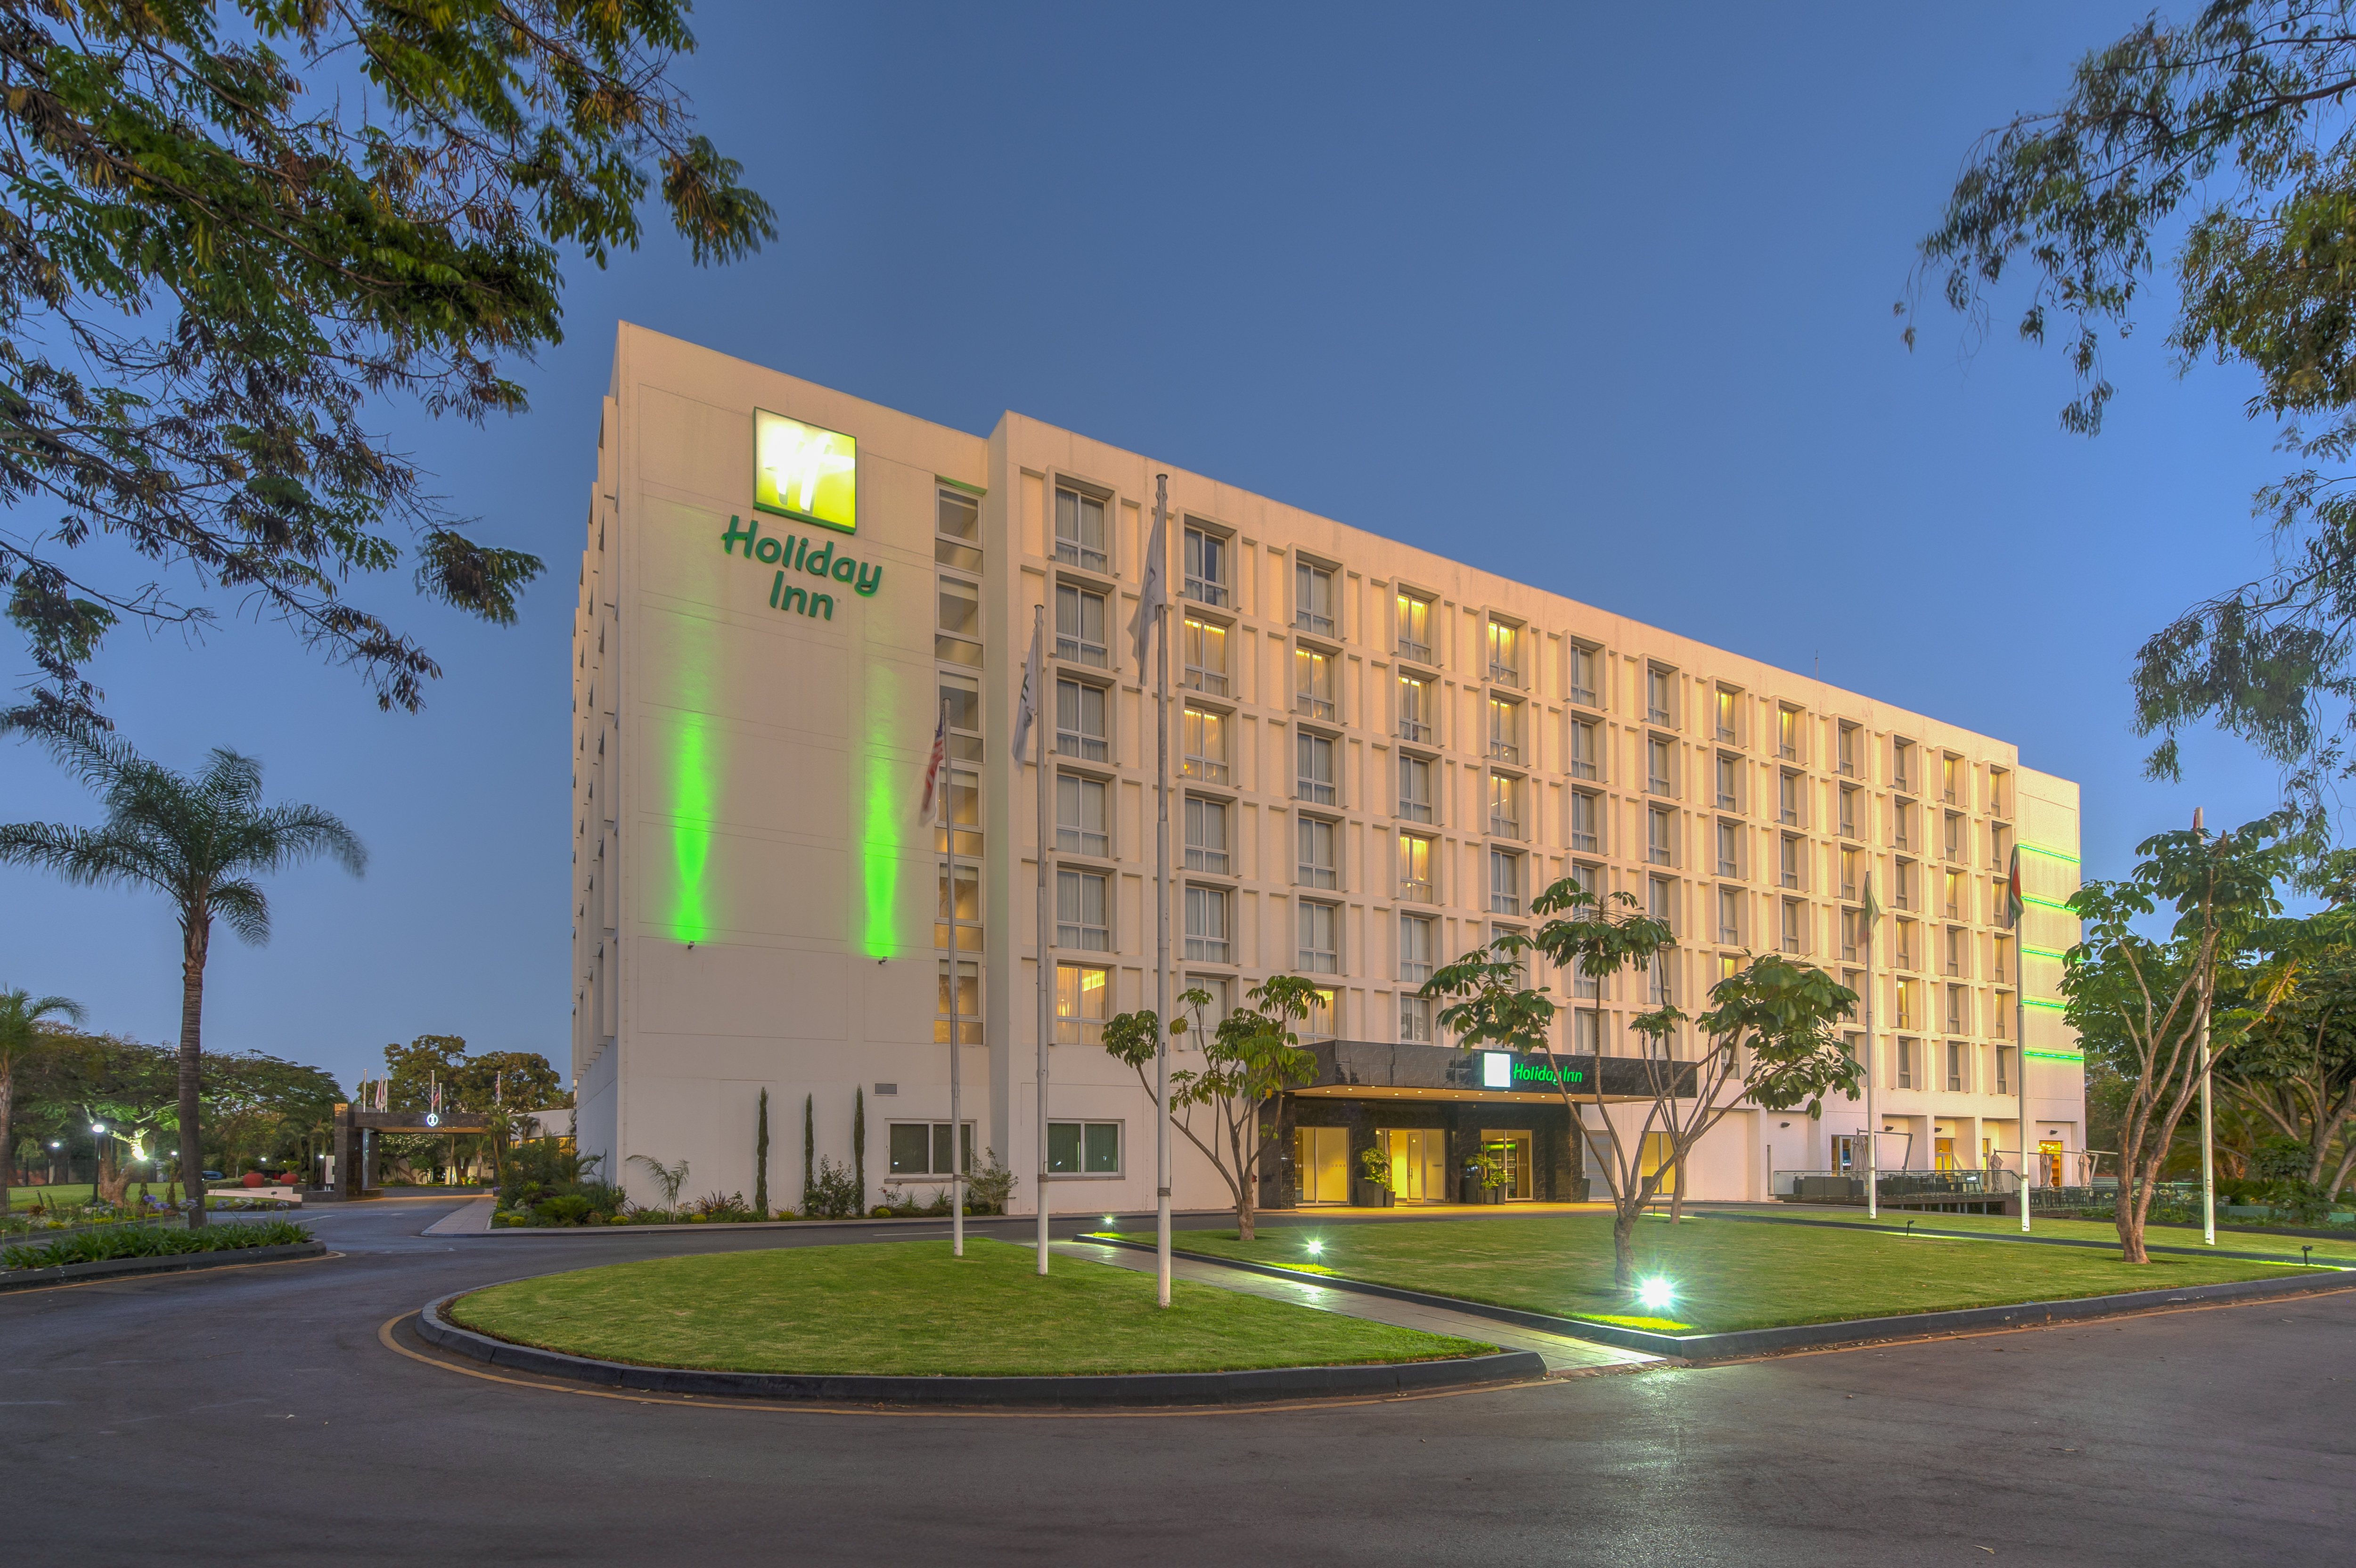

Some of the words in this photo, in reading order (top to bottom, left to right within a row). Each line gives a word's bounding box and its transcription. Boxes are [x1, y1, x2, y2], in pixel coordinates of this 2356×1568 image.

[721, 514, 882, 596] Holiday
[769, 570, 834, 621] Inn
[1563, 1066, 1582, 1083] Inn
